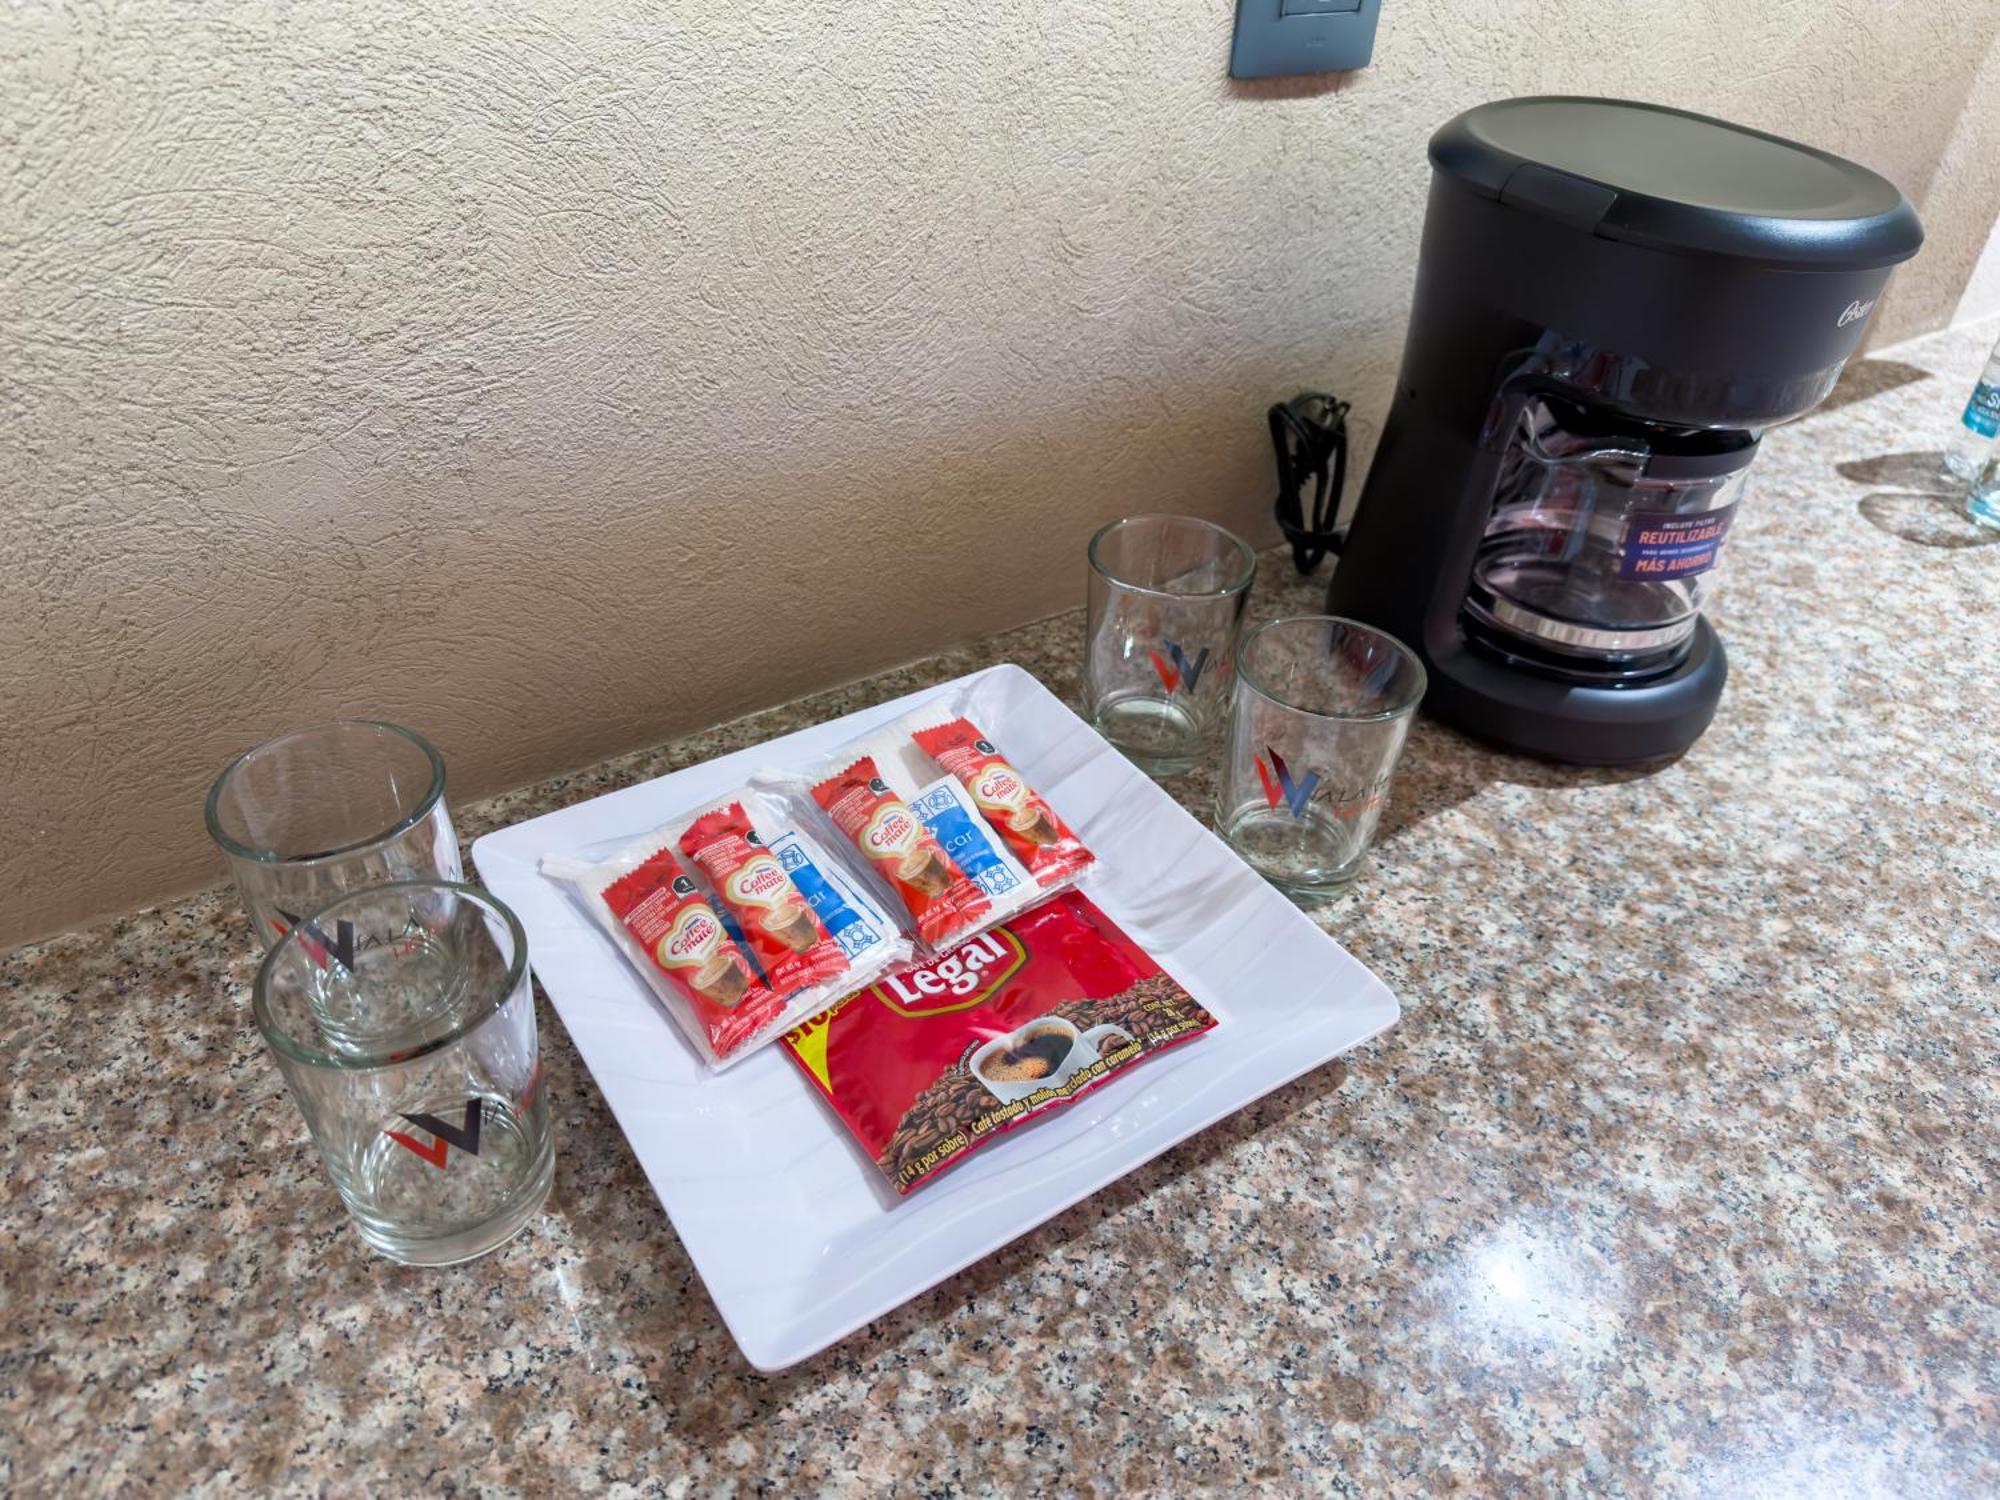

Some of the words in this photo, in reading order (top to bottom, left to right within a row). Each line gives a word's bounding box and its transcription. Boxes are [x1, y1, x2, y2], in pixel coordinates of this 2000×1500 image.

[871, 815, 904, 846] Coffee
[884, 820, 911, 846] mate
[946, 830, 972, 852] car
[740, 868, 778, 894] Coffee
[755, 875, 785, 895] mate
[671, 918, 709, 956] Coffee
[684, 925, 714, 954] mate
[884, 932, 1008, 1005] Legal
[971, 1114, 993, 1134] Café
[992, 1100, 1025, 1125] tostado
[899, 1165, 915, 1185] (14
[914, 1159, 925, 1175] g
[920, 1150, 939, 1172] por
[937, 1130, 970, 1158] sobre)
